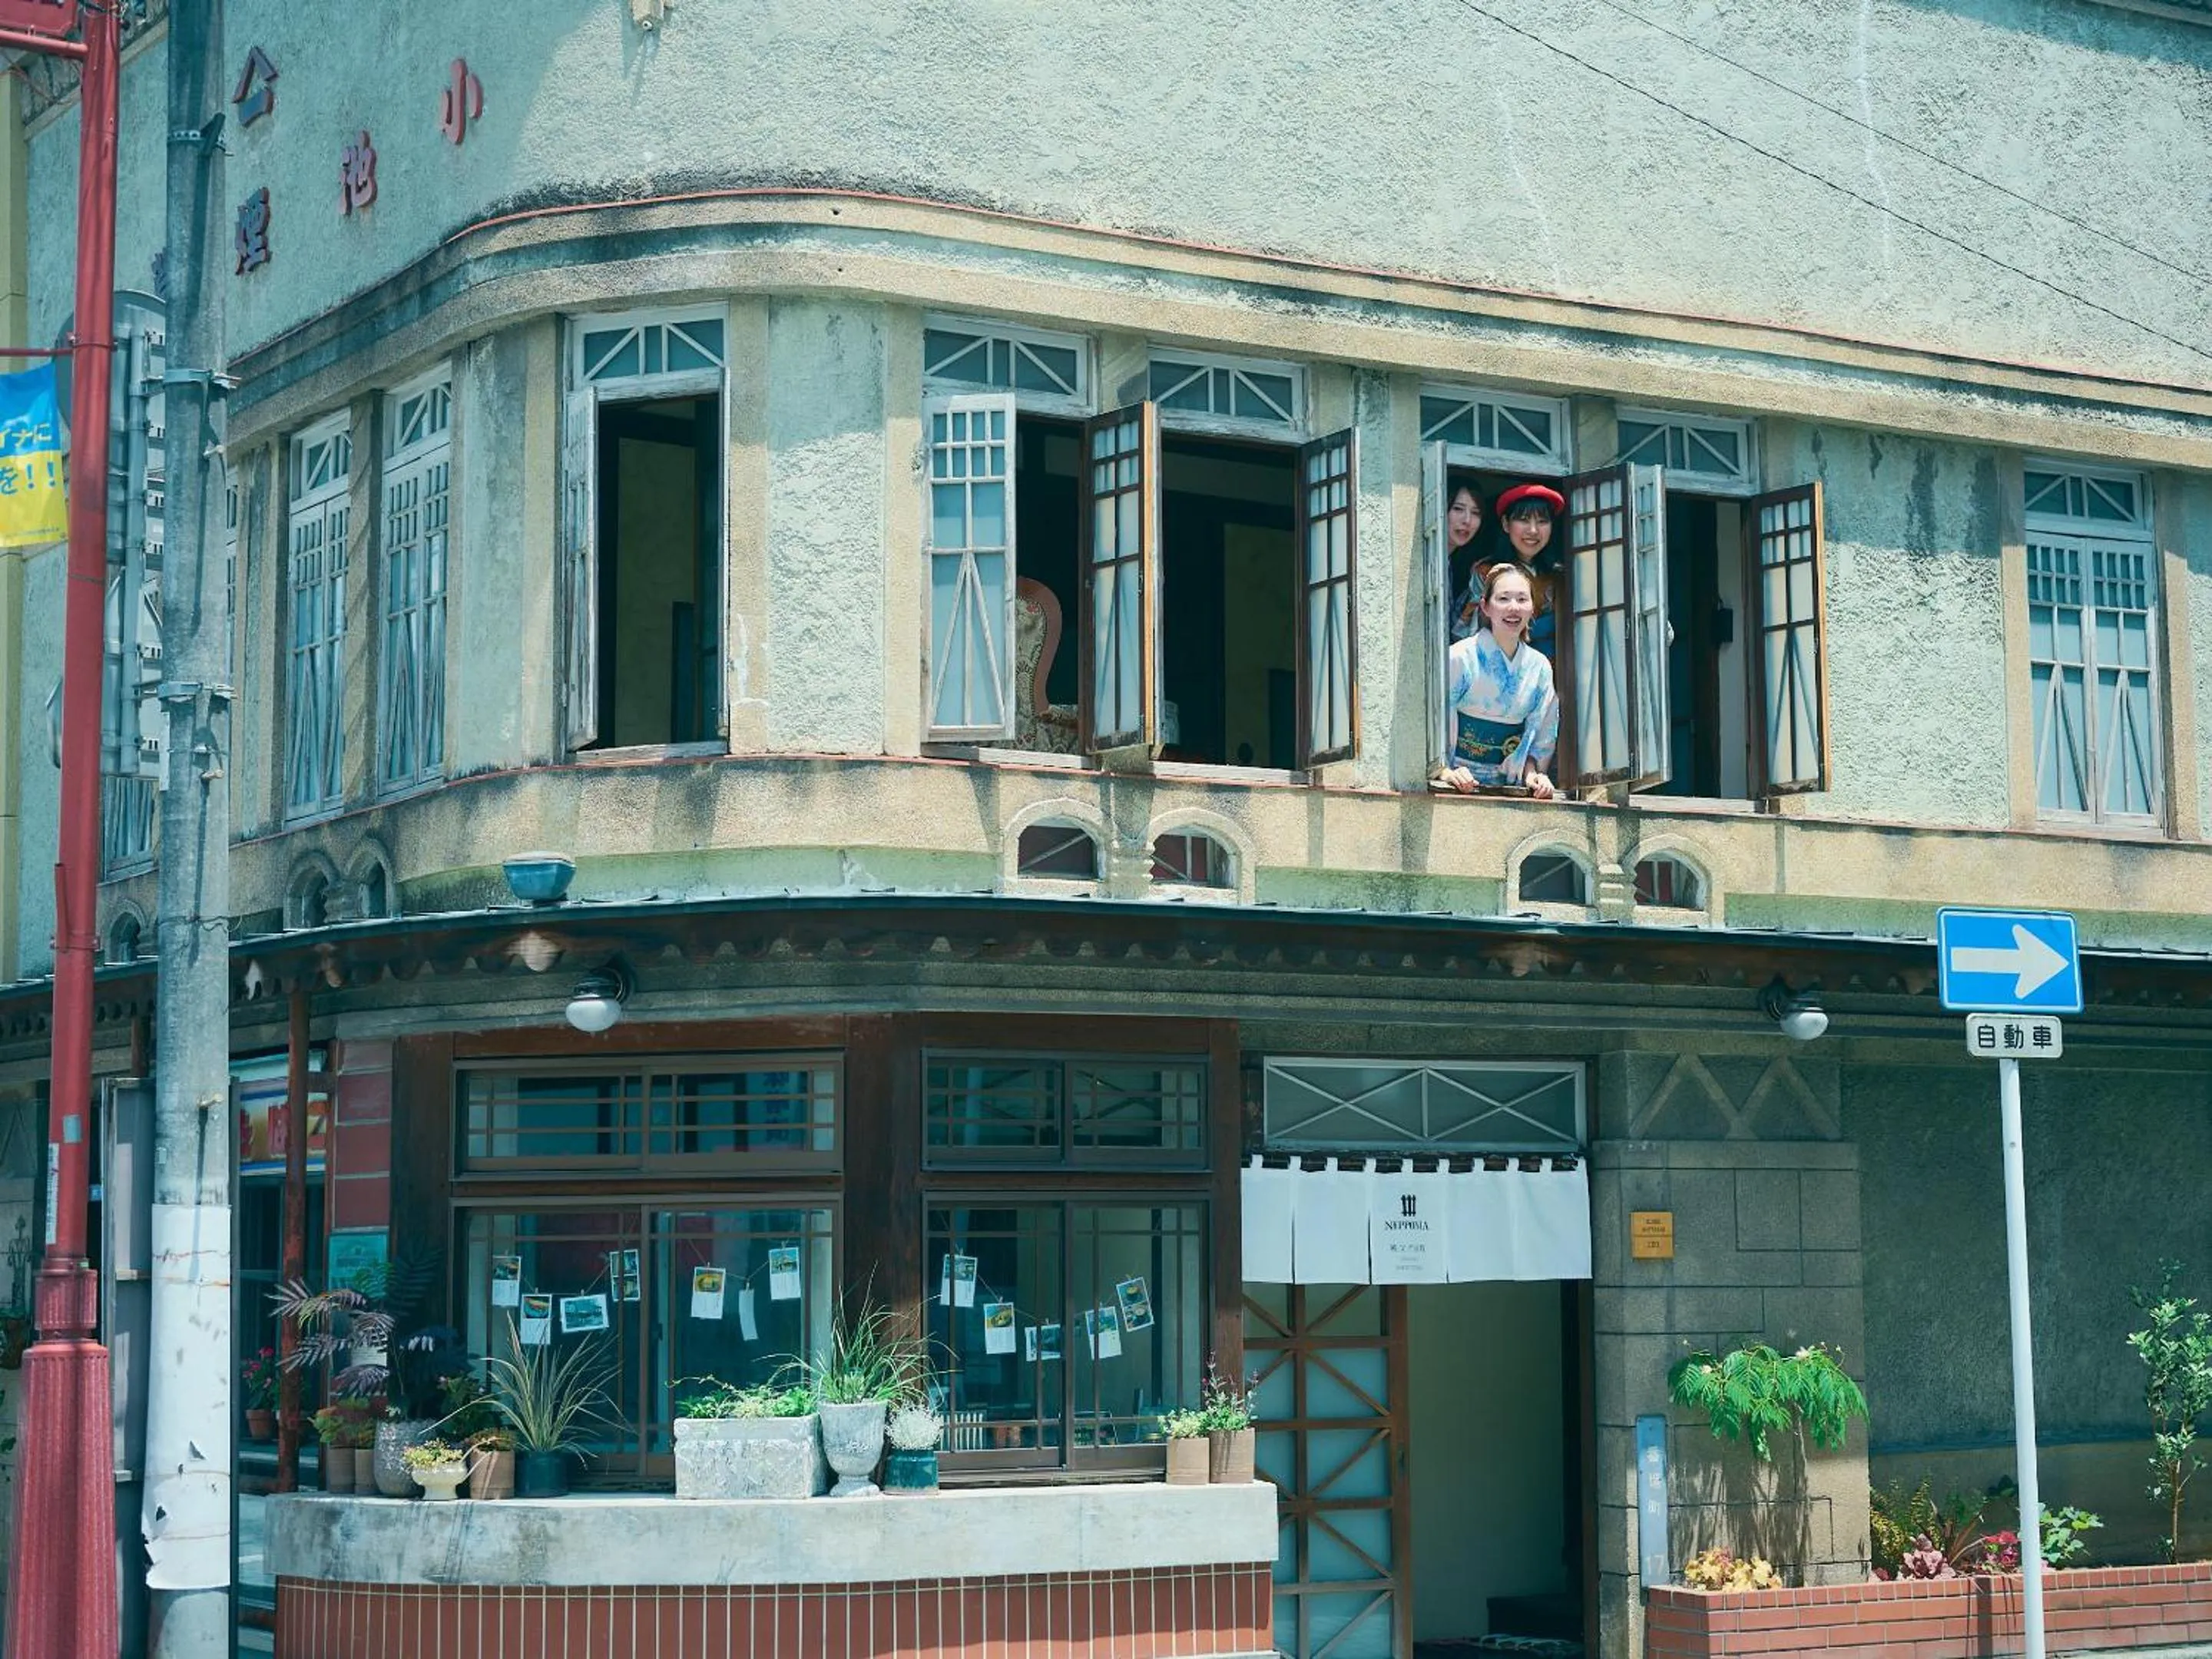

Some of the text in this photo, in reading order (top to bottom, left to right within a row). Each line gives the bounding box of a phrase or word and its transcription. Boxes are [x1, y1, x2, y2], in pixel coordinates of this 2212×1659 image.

[1977, 1024, 2053, 1049] 自動車
[1644, 1554, 1665, 1575] 17
